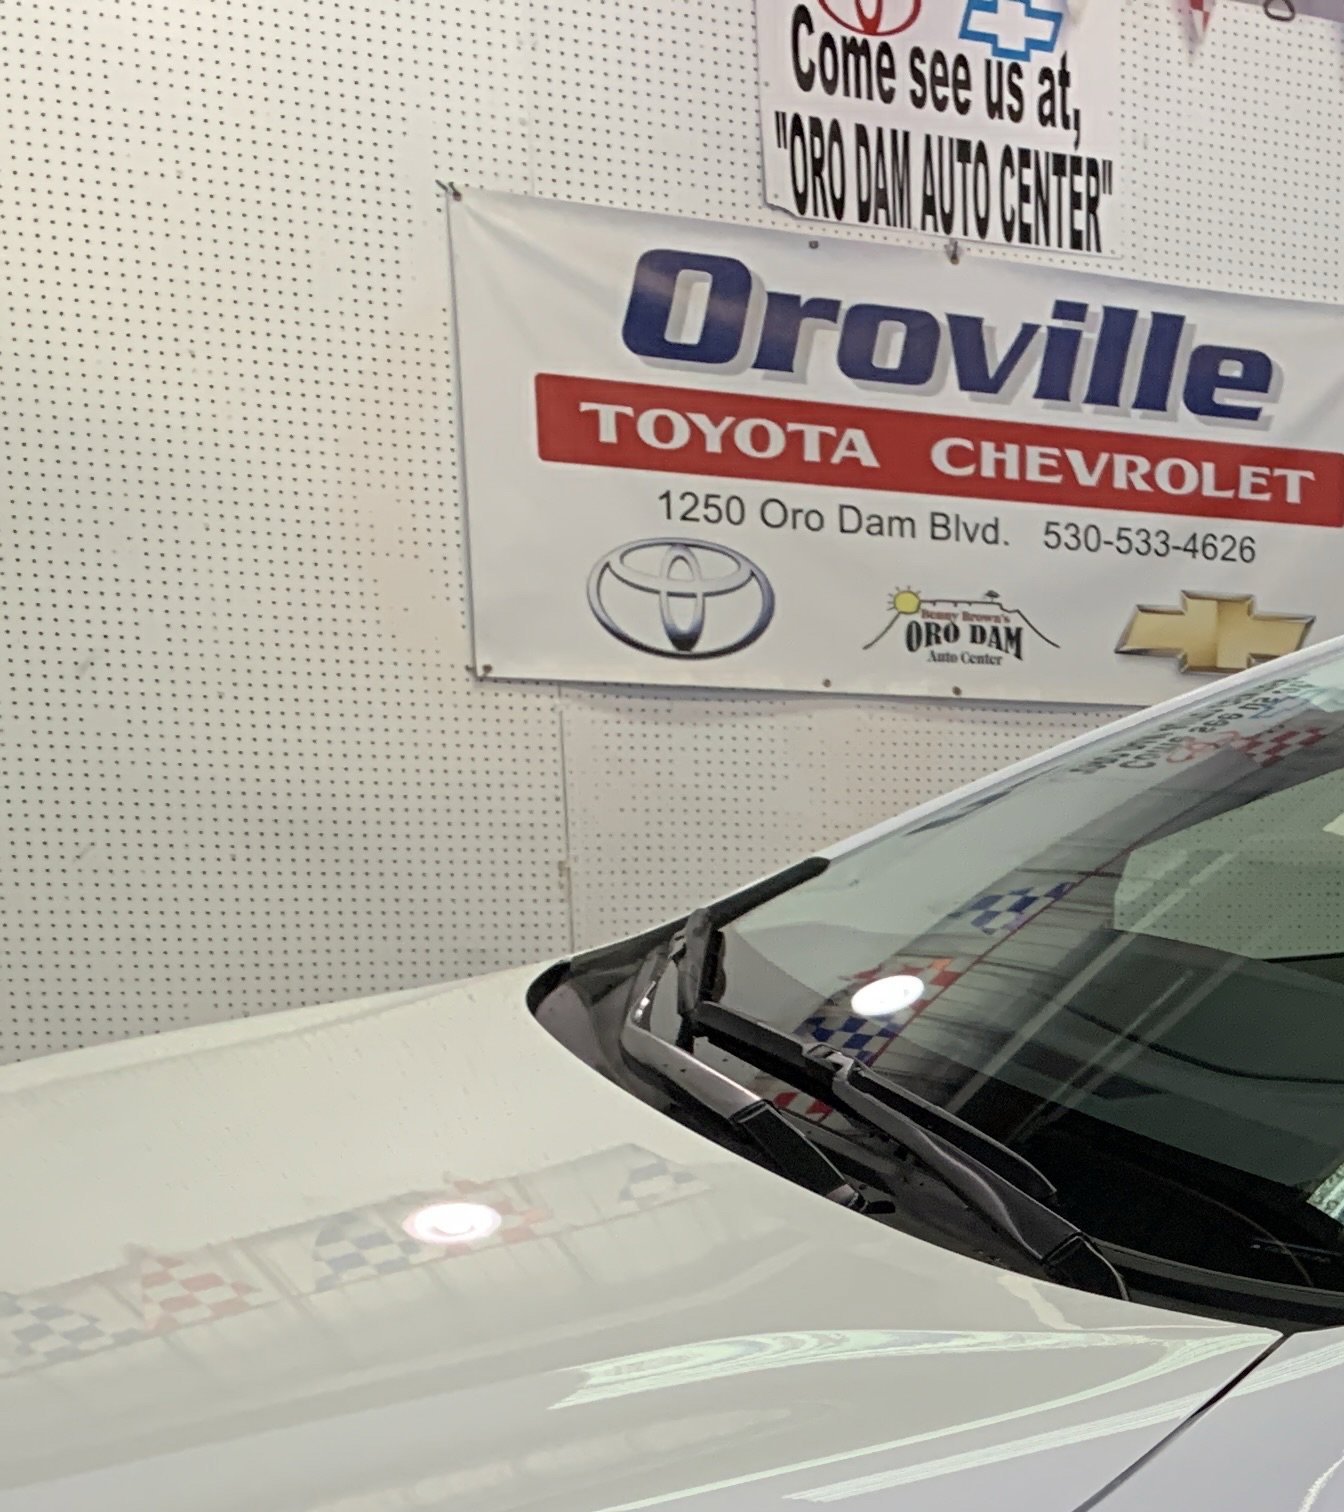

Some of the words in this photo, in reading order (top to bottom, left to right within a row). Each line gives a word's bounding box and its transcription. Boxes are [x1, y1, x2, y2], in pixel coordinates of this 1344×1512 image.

[791, 4, 896, 104] Come
[909, 46, 972, 115] see
[985, 58, 1024, 123] us
[1037, 51, 1081, 151] at,
[775, 110, 846, 221] "ORO
[854, 122, 912, 230] DAM
[921, 134, 991, 240] AUTO
[1000, 144, 1113, 253] CENTER"
[621, 248, 1275, 422] Oroville
[578, 400, 881, 469] TOYOTA
[929, 435, 1317, 506] CHEVROLET
[657, 489, 747, 527] 1250
[759, 497, 826, 533] Oro
[837, 503, 918, 540] Dam
[929, 510, 1011, 547] Blvd.
[1043, 519, 1258, 565] 530-533-4626
[905, 620, 961, 653] ORO
[969, 623, 1024, 661] DAM
[920, 608, 960, 623] Benny
[961, 610, 1012, 624] Brown's
[927, 650, 959, 664] Auto
[960, 651, 1003, 666] Center
